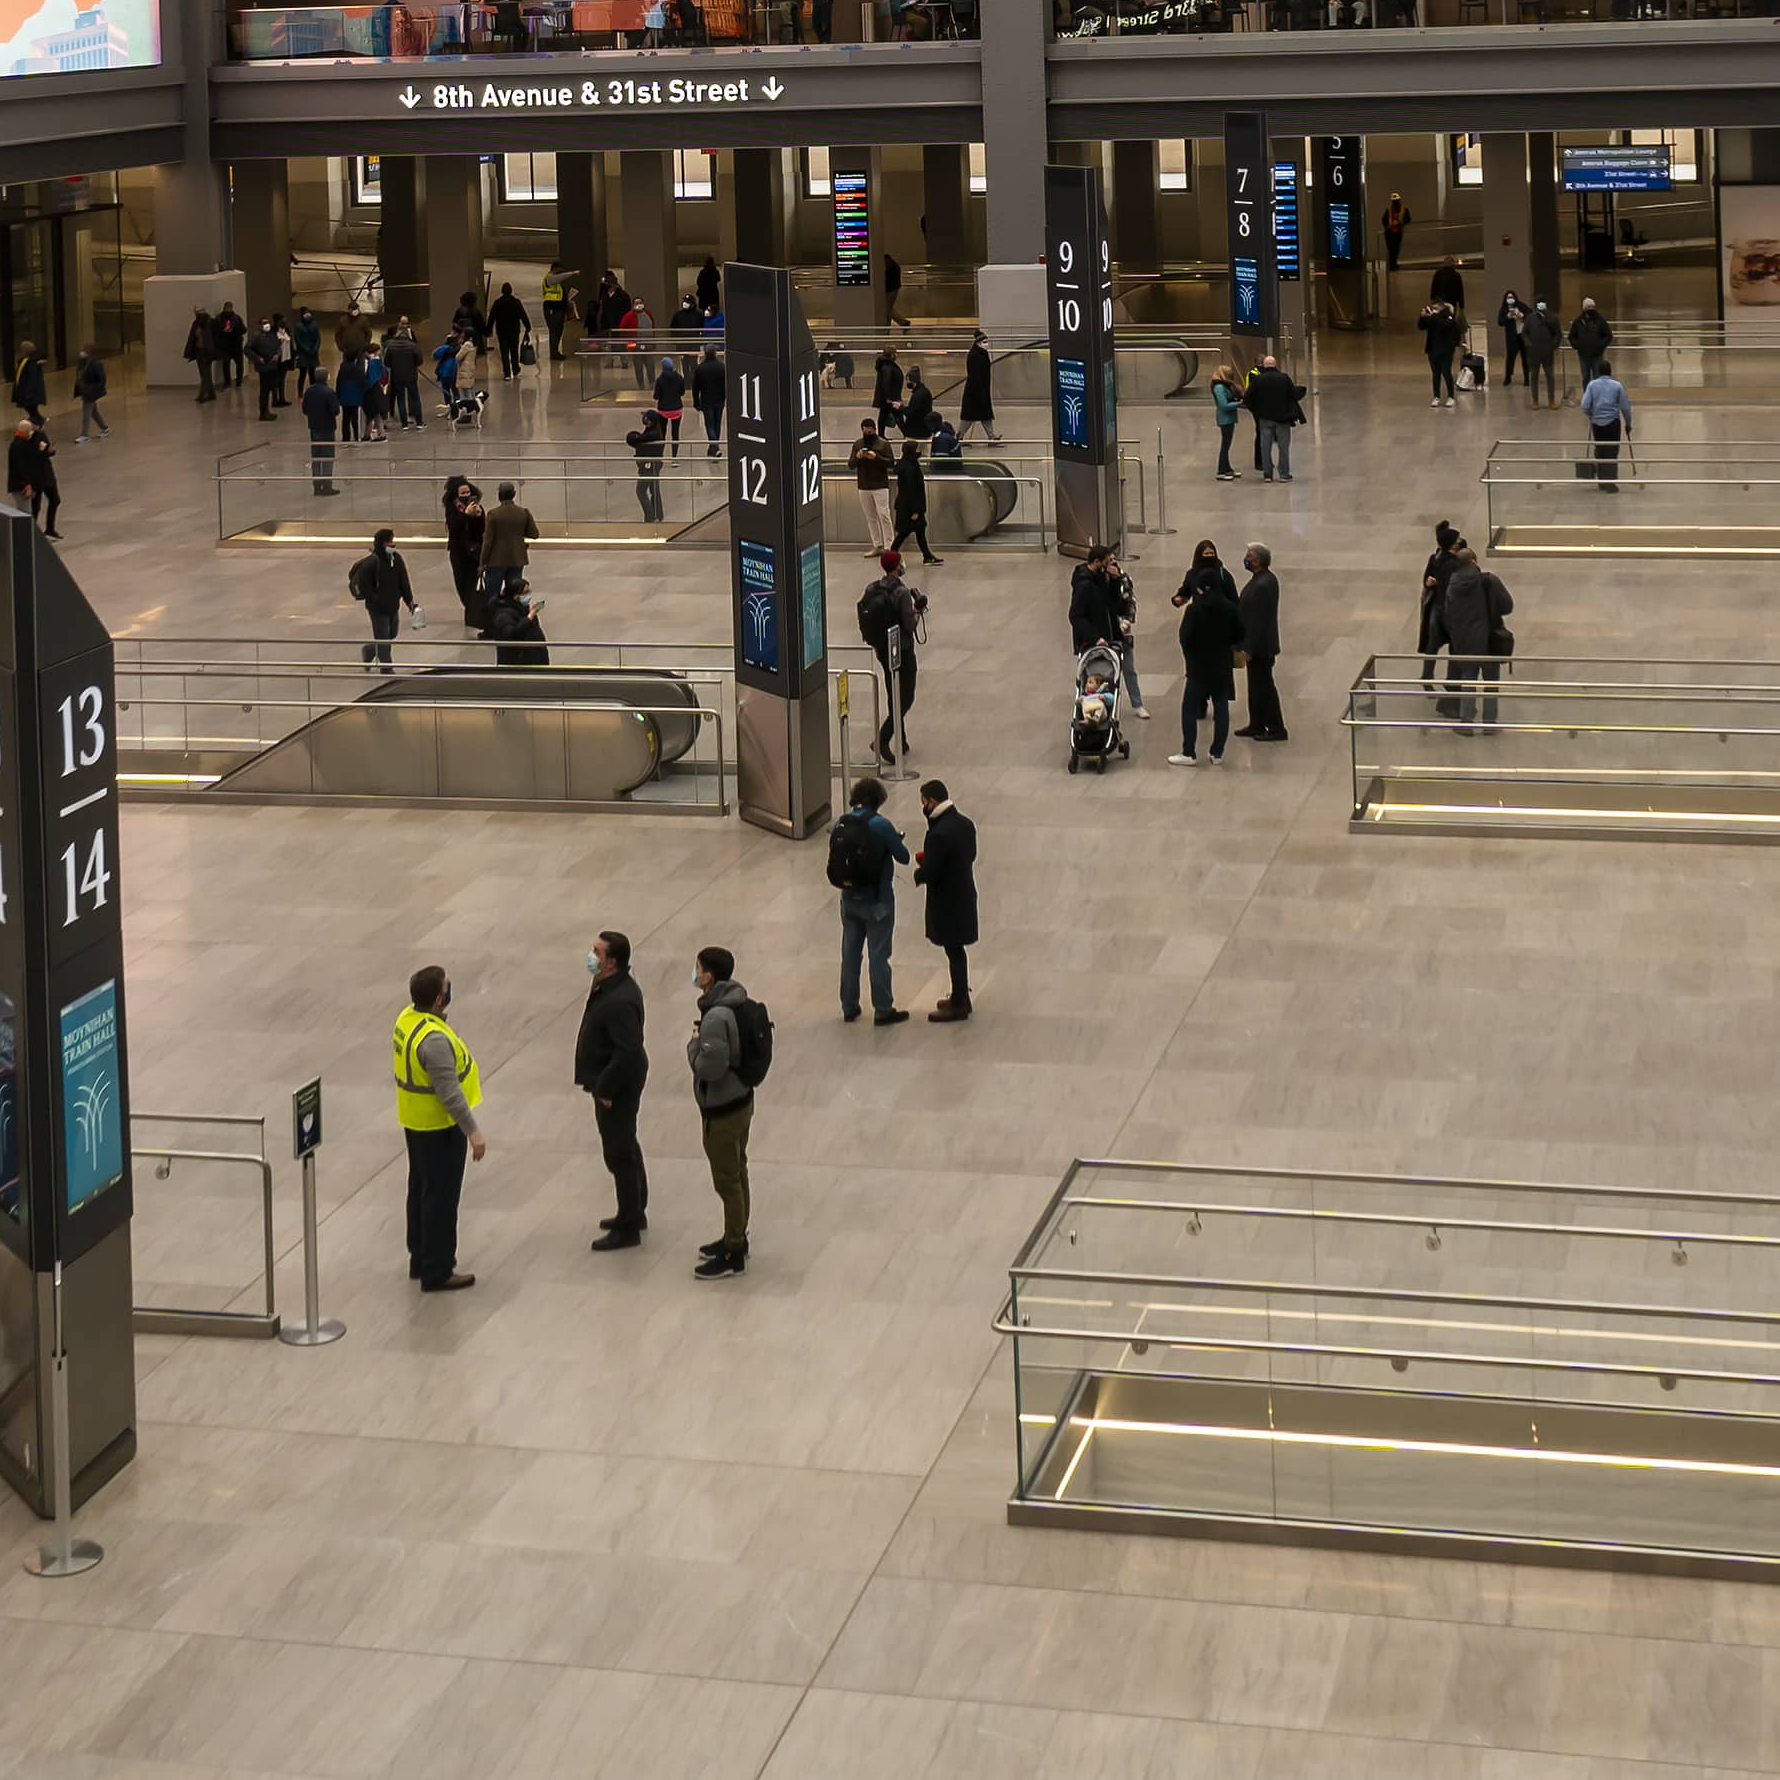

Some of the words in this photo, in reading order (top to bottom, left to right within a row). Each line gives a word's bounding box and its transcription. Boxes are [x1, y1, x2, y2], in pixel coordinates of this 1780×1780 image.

[433, 84, 474, 108] 8th
[481, 83, 573, 108] Avenue
[580, 81, 600, 105] &
[608, 80, 662, 105] 31st
[668, 78, 749, 103] Street
[1237, 168, 1248, 193] 7
[1333, 165, 1343, 186] 6
[1239, 212, 1250, 236] 8
[1059, 241, 1074, 273] 9
[1101, 240, 1109, 273] 9
[1058, 299, 1081, 332] 10
[1103, 298, 1113, 332] 10
[739, 372, 763, 422] 11
[799, 370, 816, 421] 11
[739, 455, 768, 506] 12
[801, 453, 819, 507] 12
[57, 684, 105, 778] 13
[60, 828, 111, 928] 14
[62, 1006, 115, 1049] MOYNIHAN
[63, 1035, 93, 1066] TRAIN
[93, 1023, 116, 1051] HALL
